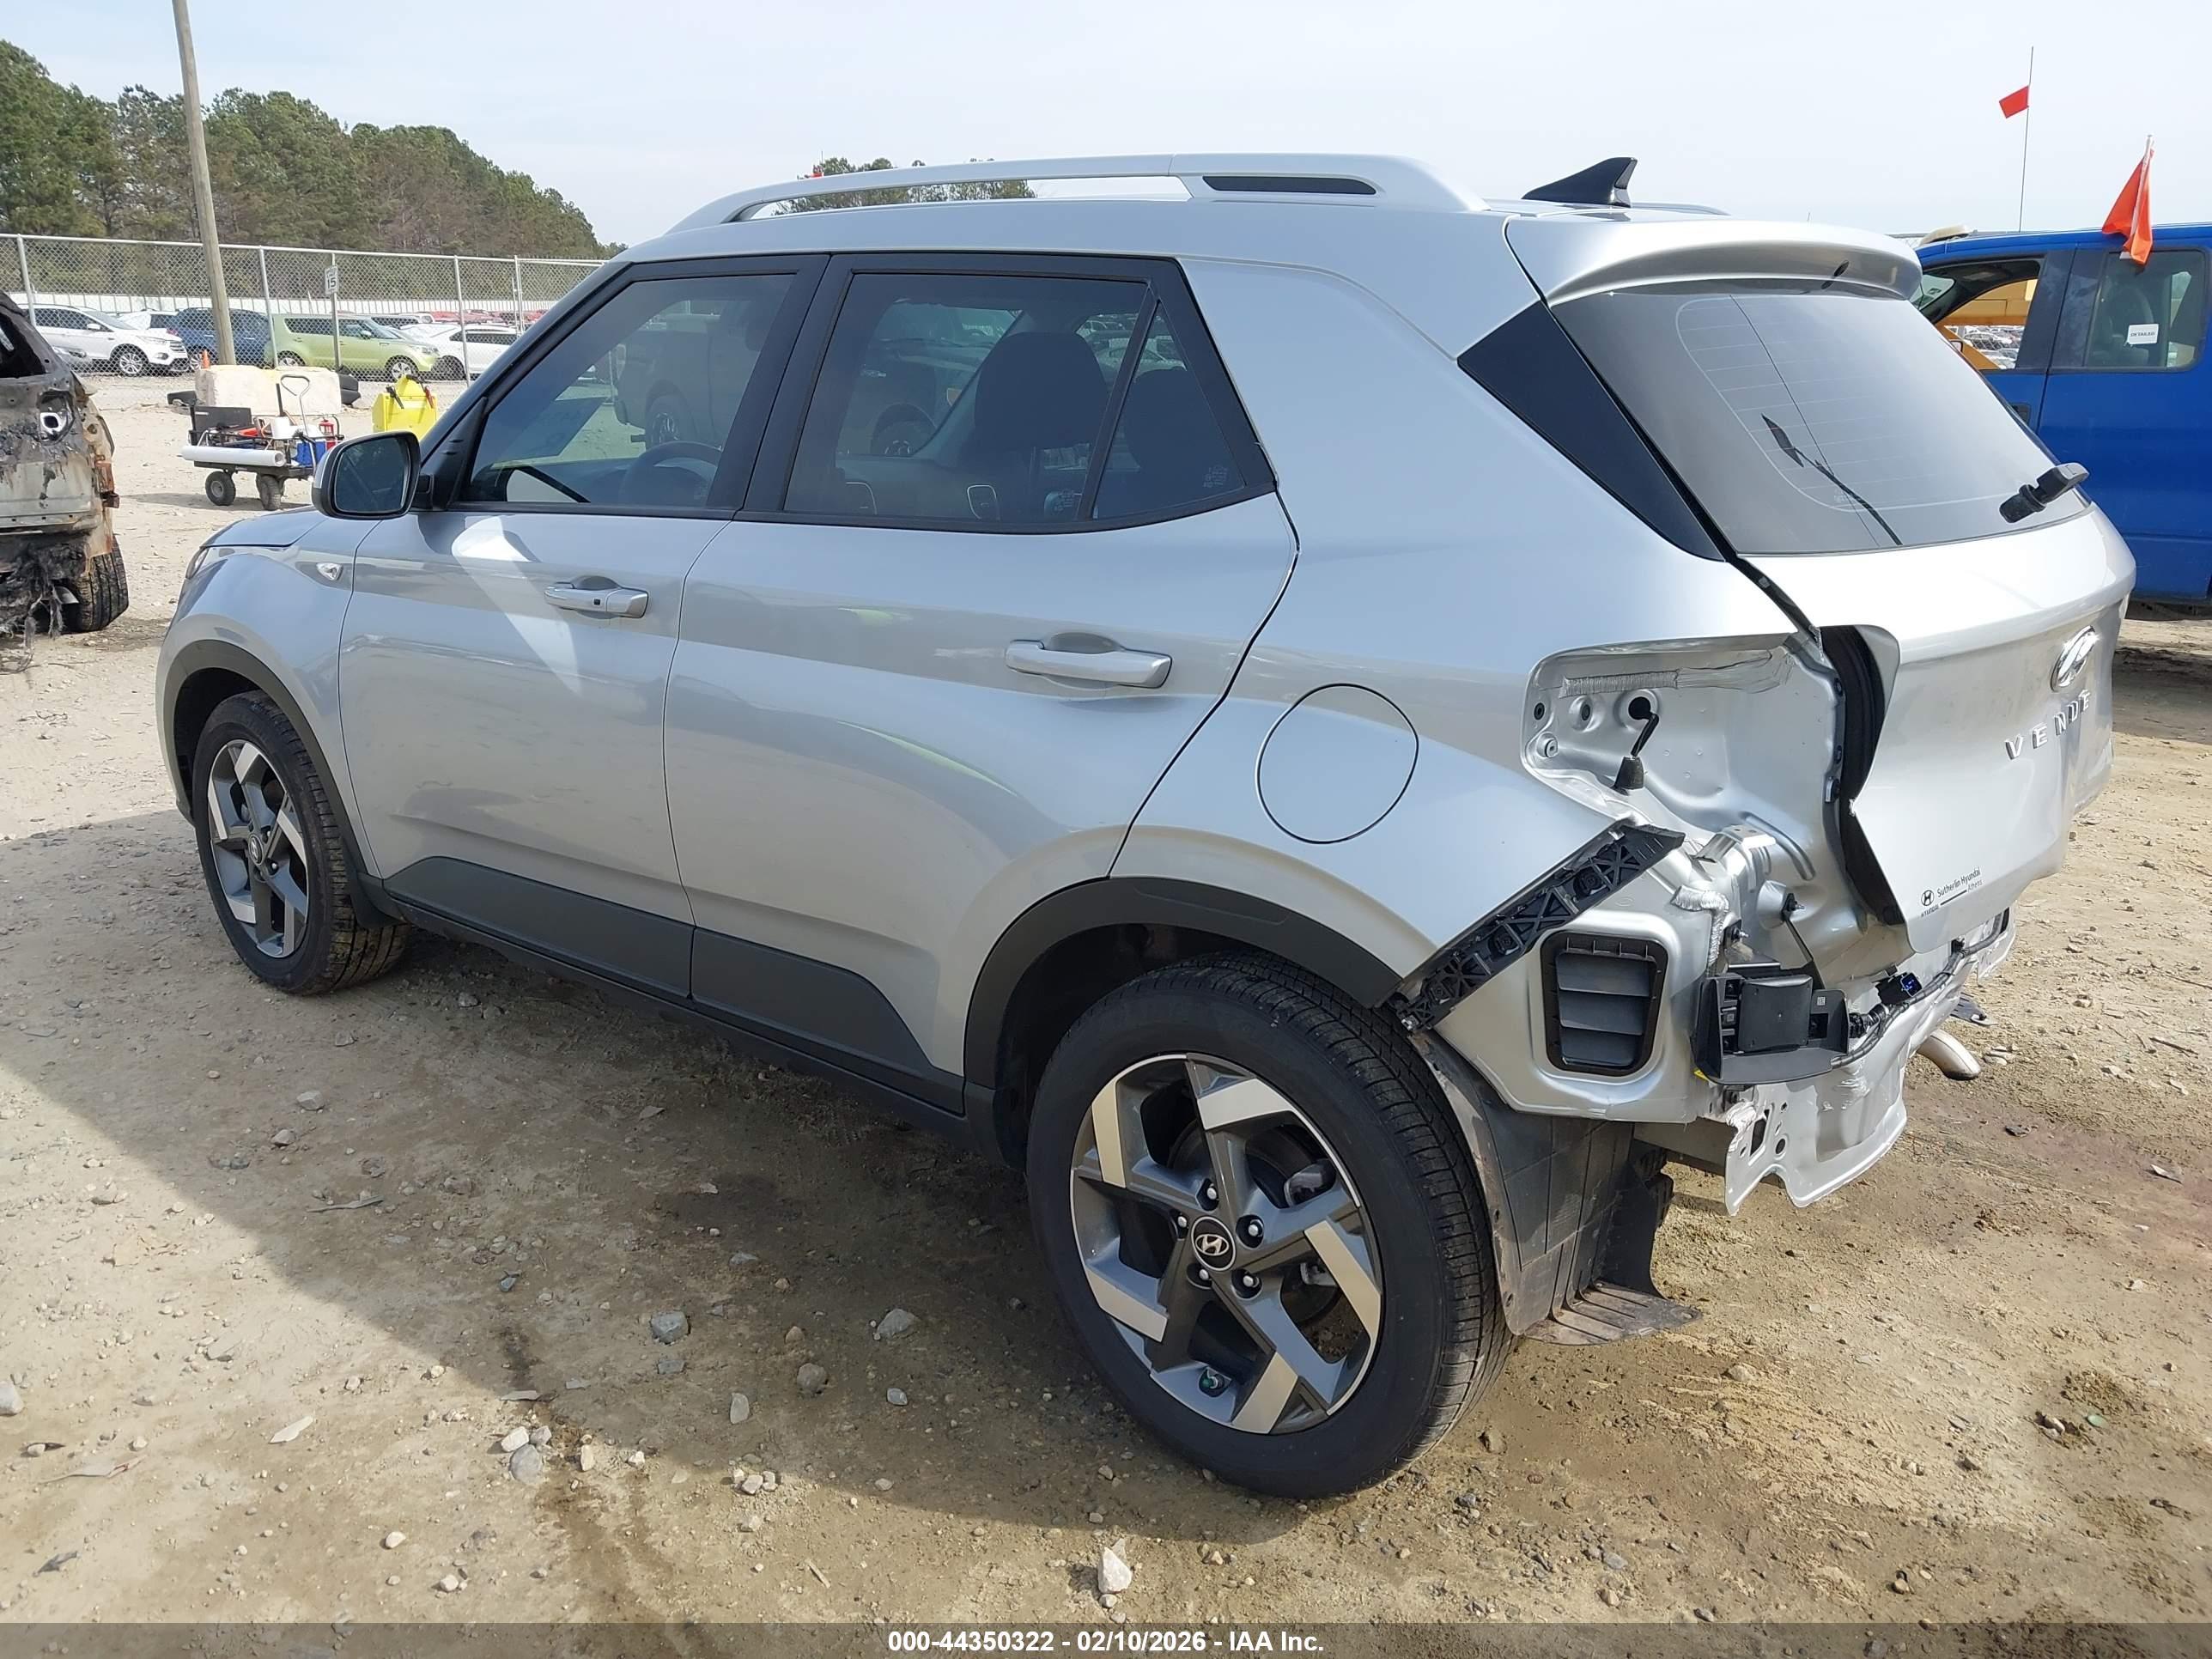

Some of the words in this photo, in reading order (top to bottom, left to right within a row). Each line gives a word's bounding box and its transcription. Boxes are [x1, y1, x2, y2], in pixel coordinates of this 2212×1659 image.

[327, 276, 337, 289] 15
[1936, 879, 1961, 897] Sutherlin
[1960, 866, 1981, 885] Hyundai
